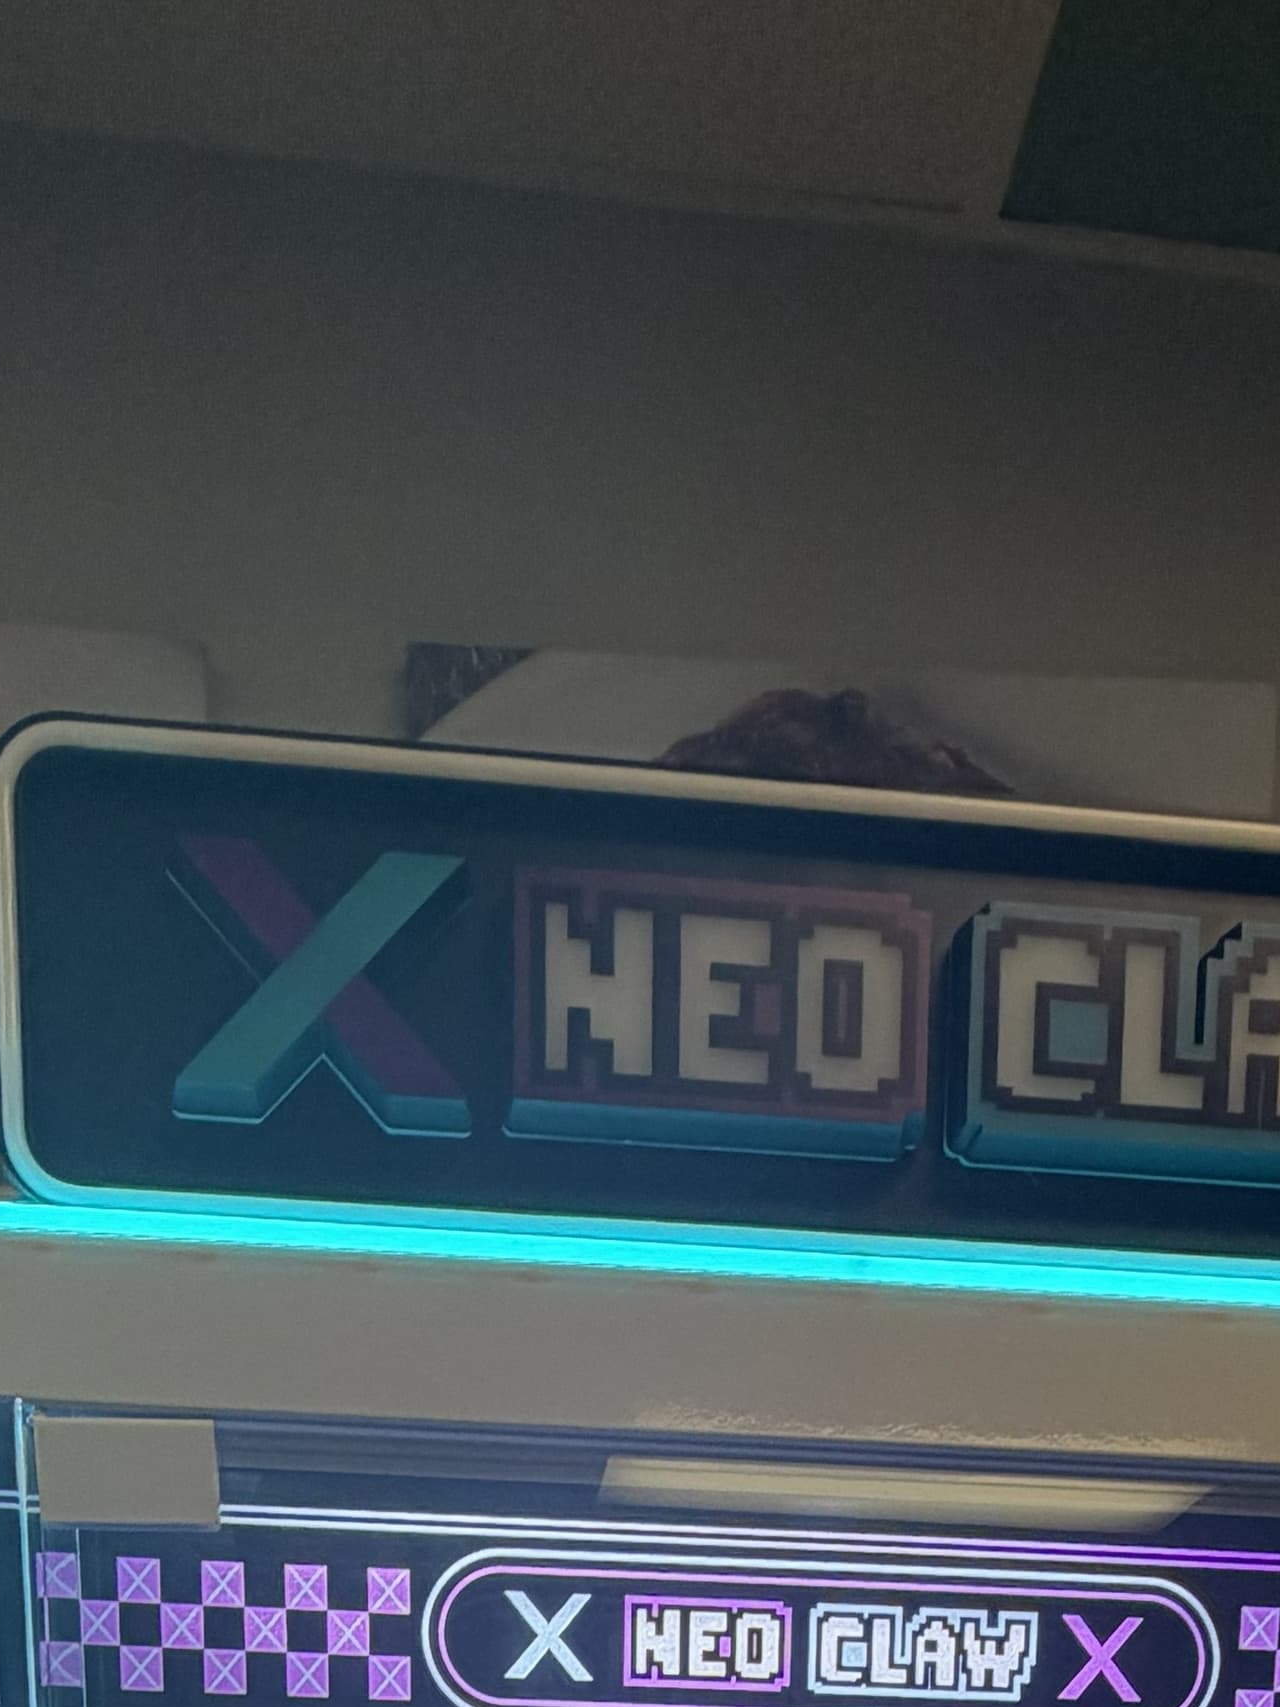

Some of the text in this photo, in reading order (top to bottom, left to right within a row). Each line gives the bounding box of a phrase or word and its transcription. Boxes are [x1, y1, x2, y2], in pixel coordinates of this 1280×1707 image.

[166, 834, 471, 1139] X
[538, 896, 912, 1098] NEO
[503, 1589, 1144, 1702] X NEO CLAW X
